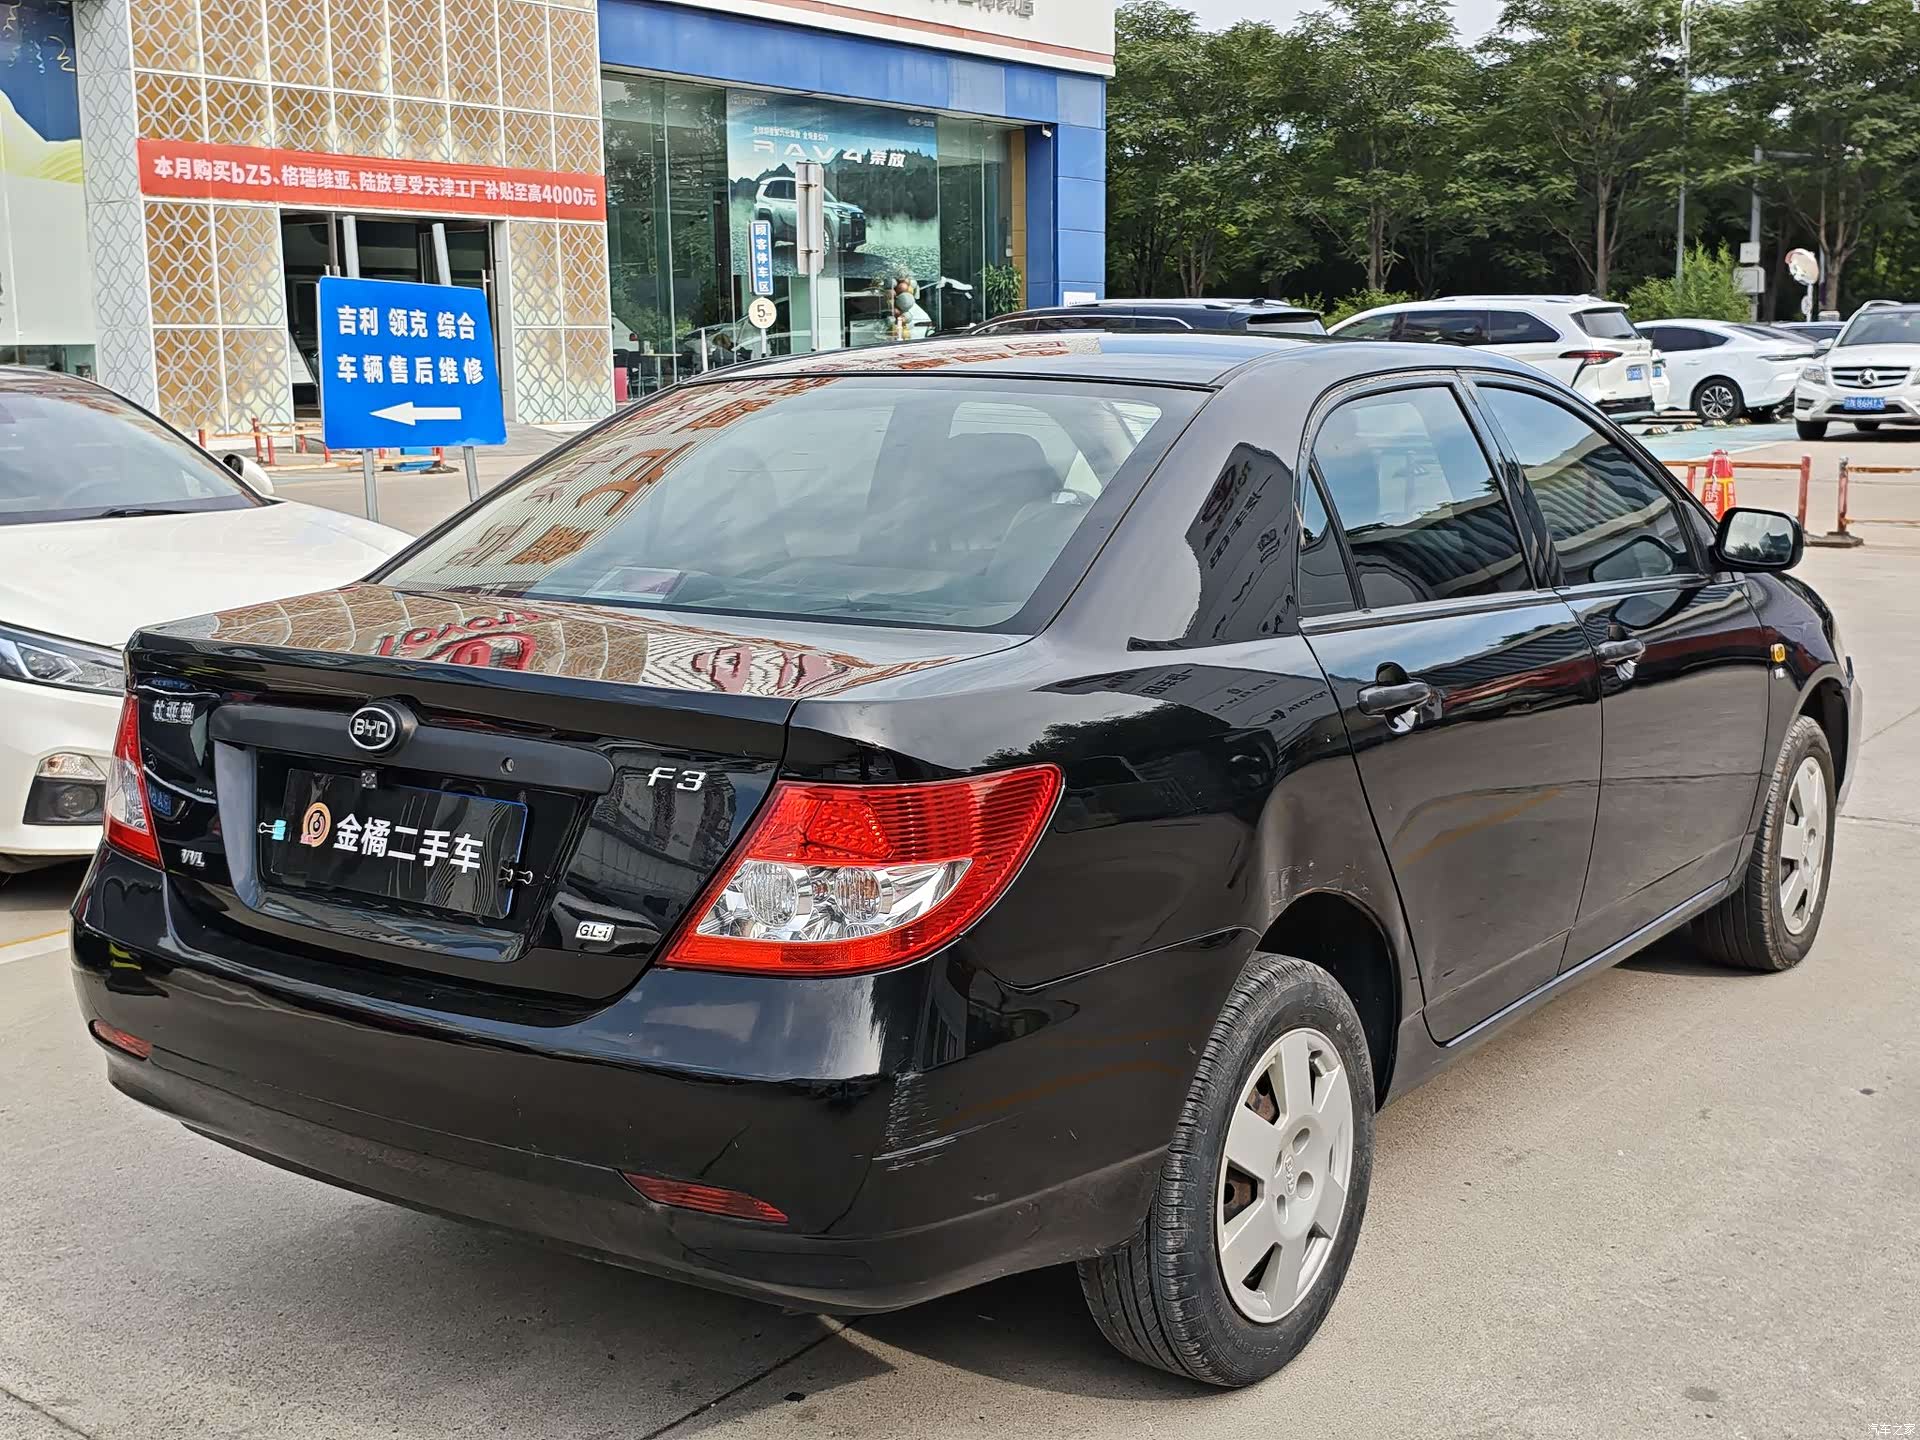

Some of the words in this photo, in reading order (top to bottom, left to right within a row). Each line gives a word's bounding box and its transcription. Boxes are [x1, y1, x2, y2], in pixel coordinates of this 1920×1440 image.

[868, 150, 906, 168] 荣放
[153, 155, 598, 207] 本月购买bZ5、格瑞维亚、陆放享受天津工厂补贴至高4000元
[755, 224, 770, 293] 顾客停车区
[336, 304, 379, 336] 吉利
[388, 308, 428, 338] 领克
[436, 311, 476, 341] 综合
[756, 304, 766, 318] 5
[336, 353, 485, 385] 车辆售后维修
[352, 717, 389, 739] BYD
[647, 766, 707, 792] F3
[333, 812, 484, 874] 金橘二手车
